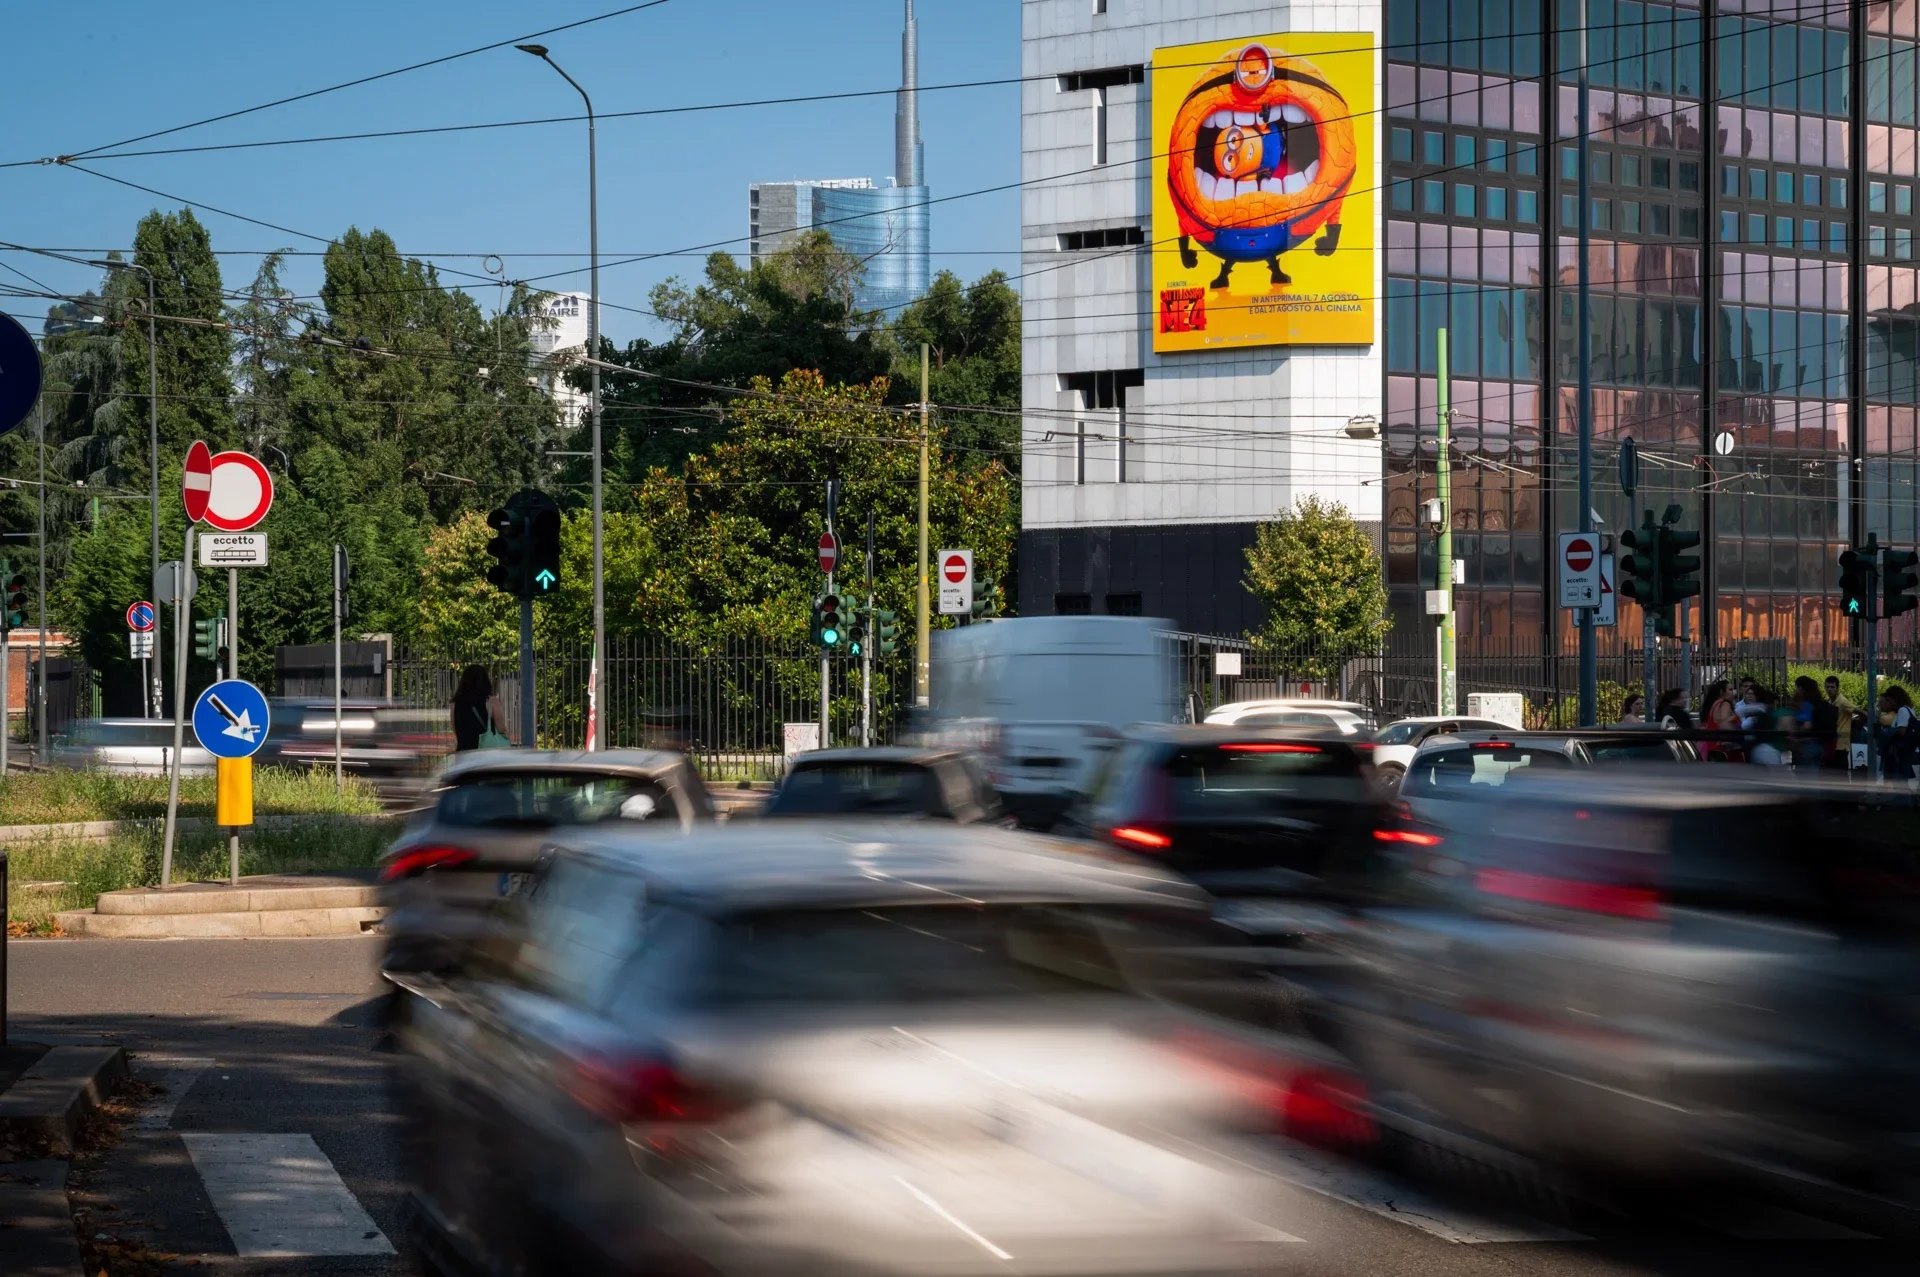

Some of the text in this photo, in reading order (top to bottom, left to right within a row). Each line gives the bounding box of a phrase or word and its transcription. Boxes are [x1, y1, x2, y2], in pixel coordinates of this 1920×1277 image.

[1251, 294, 1359, 304] IN ANTEPRIMA IL 7 AGOSTO
[1249, 307, 1254, 315] E
[1254, 306, 1267, 314] DAL
[1276, 304, 1312, 313] AGOSTO
[1313, 304, 1325, 312] AL
[1326, 304, 1362, 312] CINEMA
[213, 535, 255, 545] eccetto
